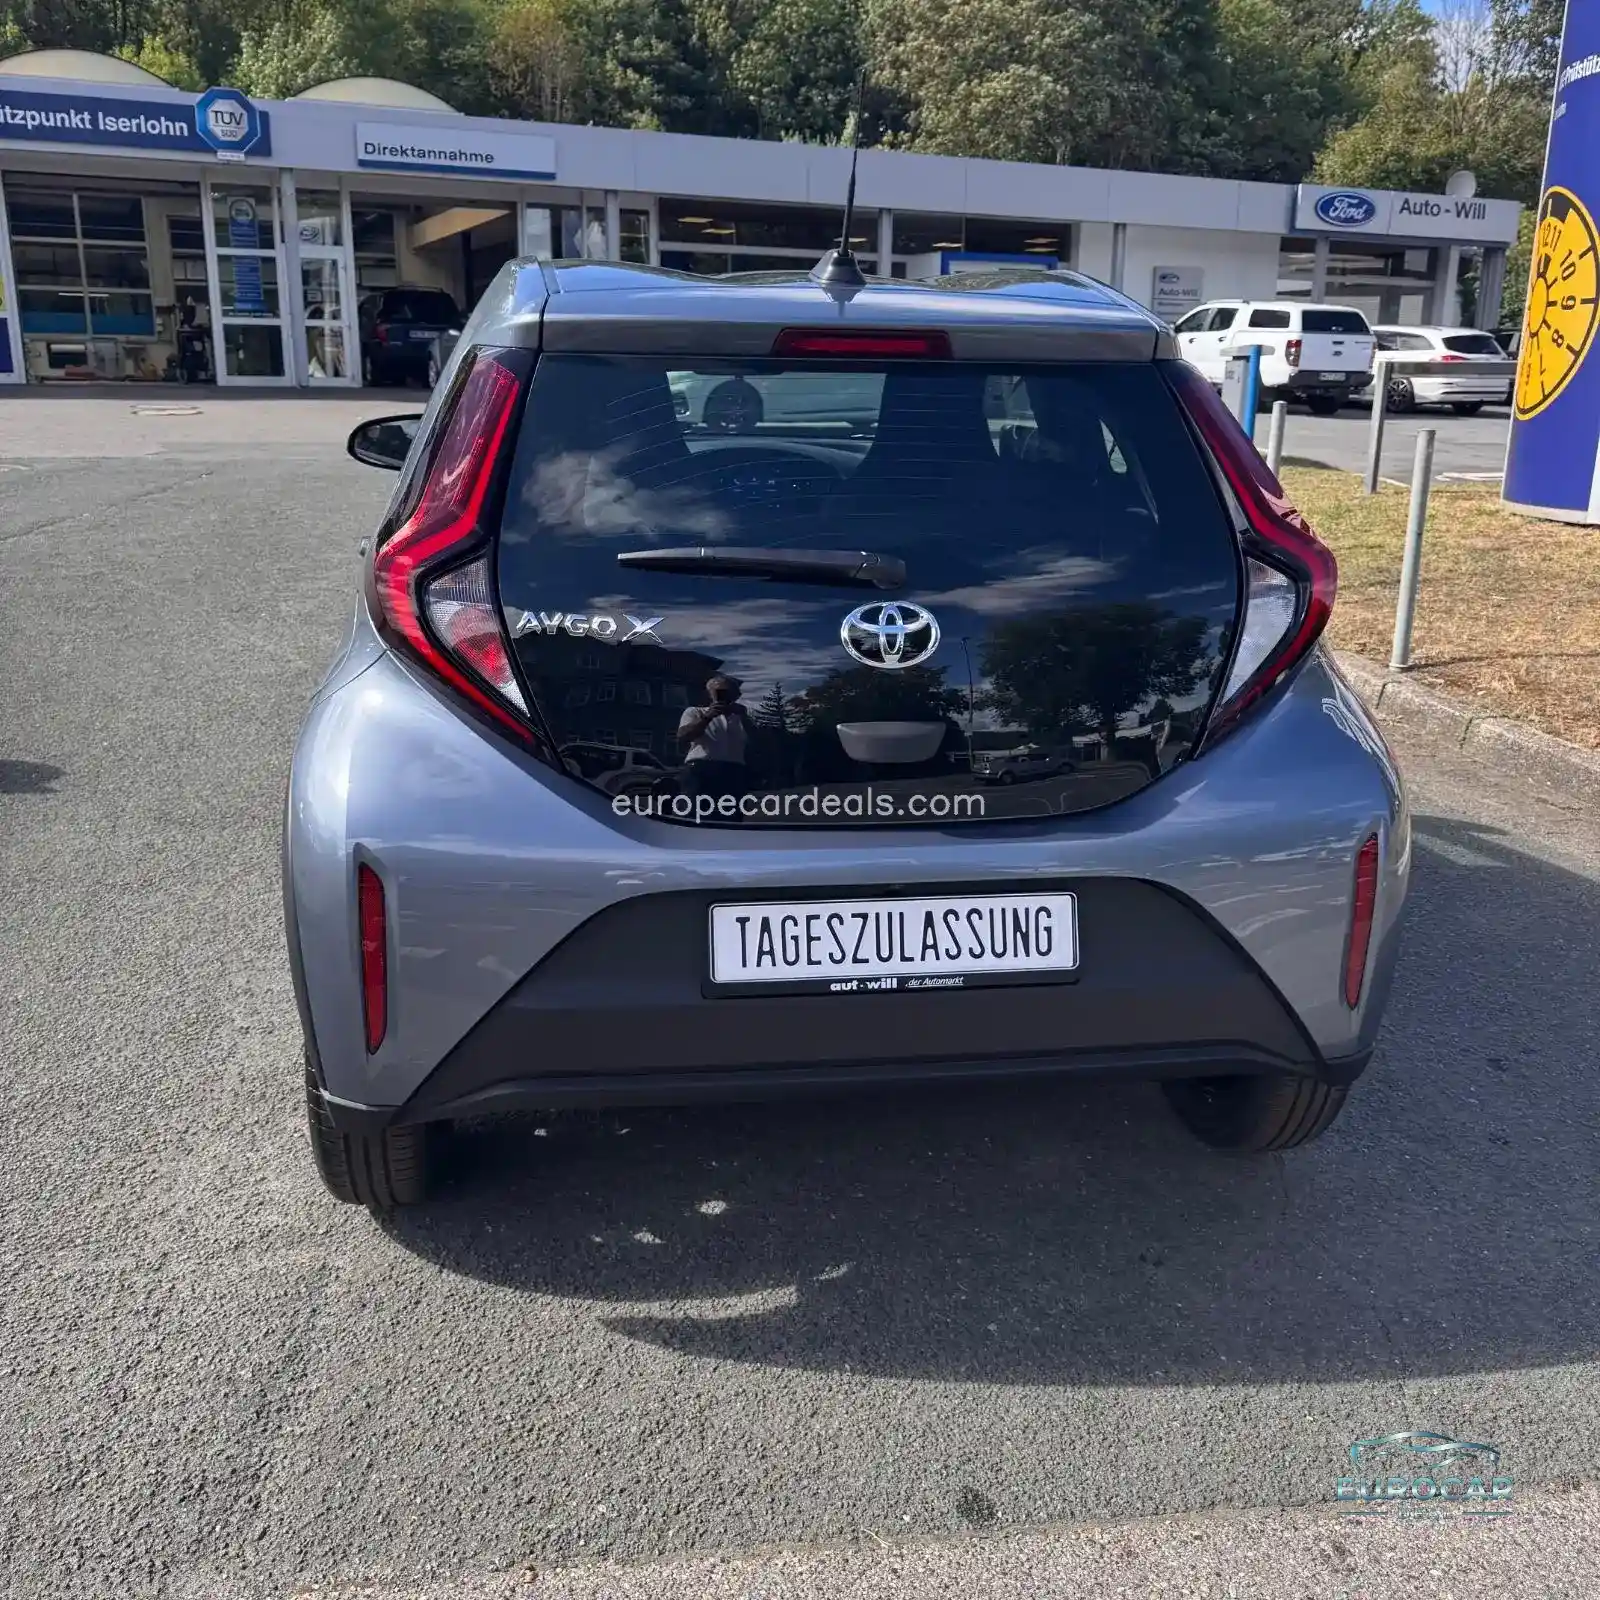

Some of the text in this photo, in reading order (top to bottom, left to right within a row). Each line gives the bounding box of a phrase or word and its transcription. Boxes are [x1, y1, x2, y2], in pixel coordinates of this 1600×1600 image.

[99, 112, 188, 136] Iserlohn
[364, 142, 495, 163] Direktannahme
[1329, 196, 1366, 220] Ford
[1400, 198, 1441, 217] Auto
[1455, 201, 1487, 220] Will
[1560, 249, 1576, 281] 10
[1552, 328, 1564, 348] 8
[516, 611, 665, 644] AYGO X
[735, 905, 1053, 968] TAGESZULASSUNG
[923, 976, 964, 986] Automarkt
